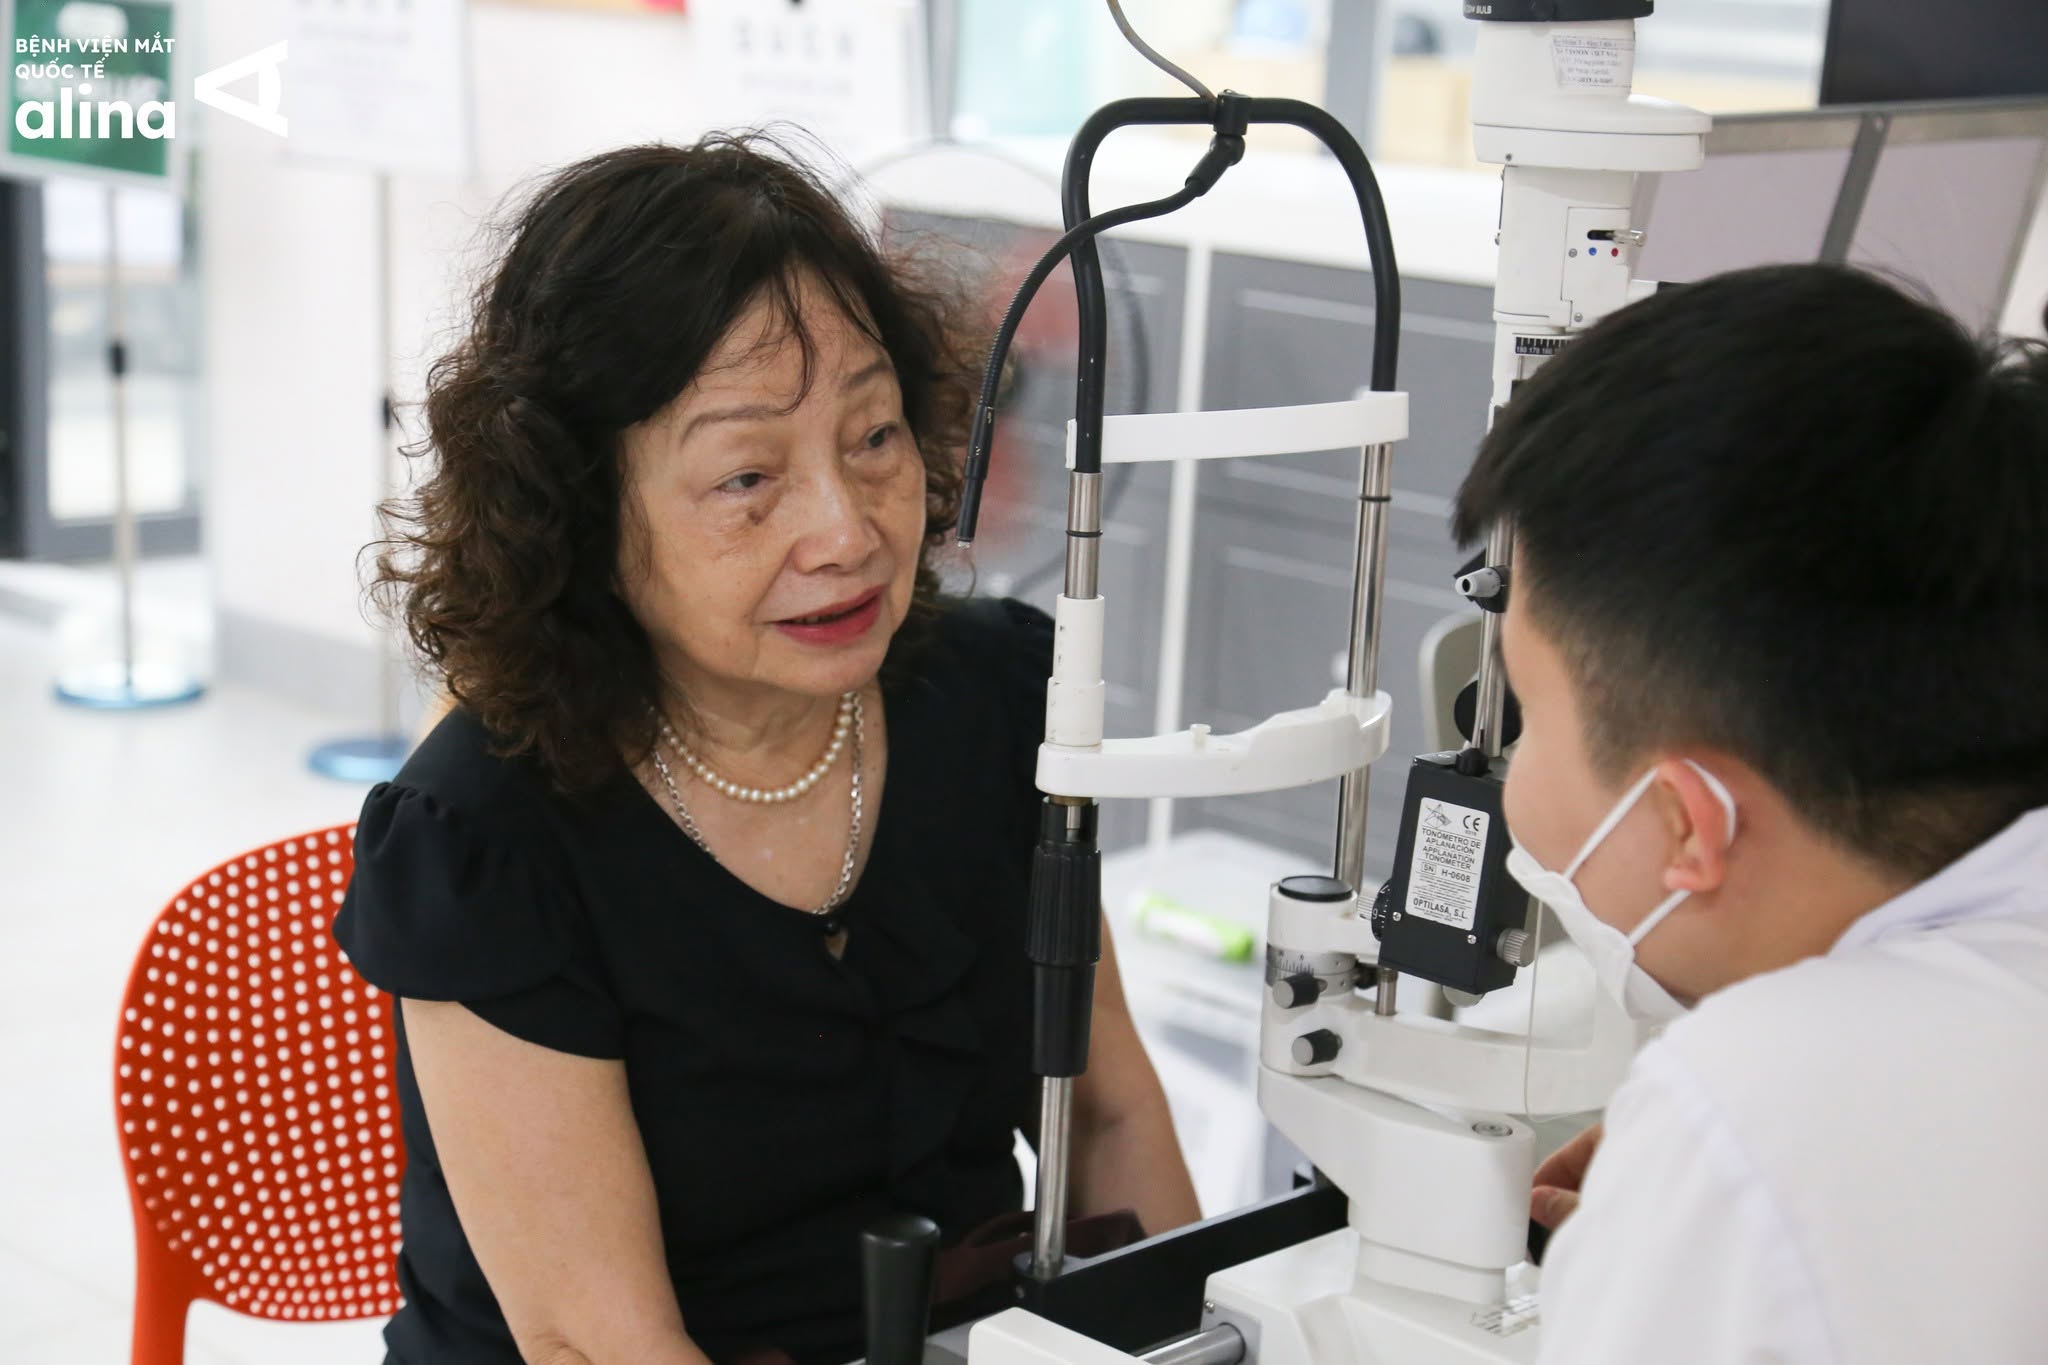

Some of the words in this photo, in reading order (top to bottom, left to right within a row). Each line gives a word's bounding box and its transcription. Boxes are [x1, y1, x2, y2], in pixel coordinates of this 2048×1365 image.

[1463, 815, 1481, 832] CE
[1422, 828, 1469, 846] TONOMETRO
[1470, 840, 1481, 849] DE
[1423, 846, 1475, 864] APPLANATION
[1425, 852, 1471, 870] TONOMETER
[1424, 863, 1434, 872] SN
[1441, 869, 1471, 883] H-0608
